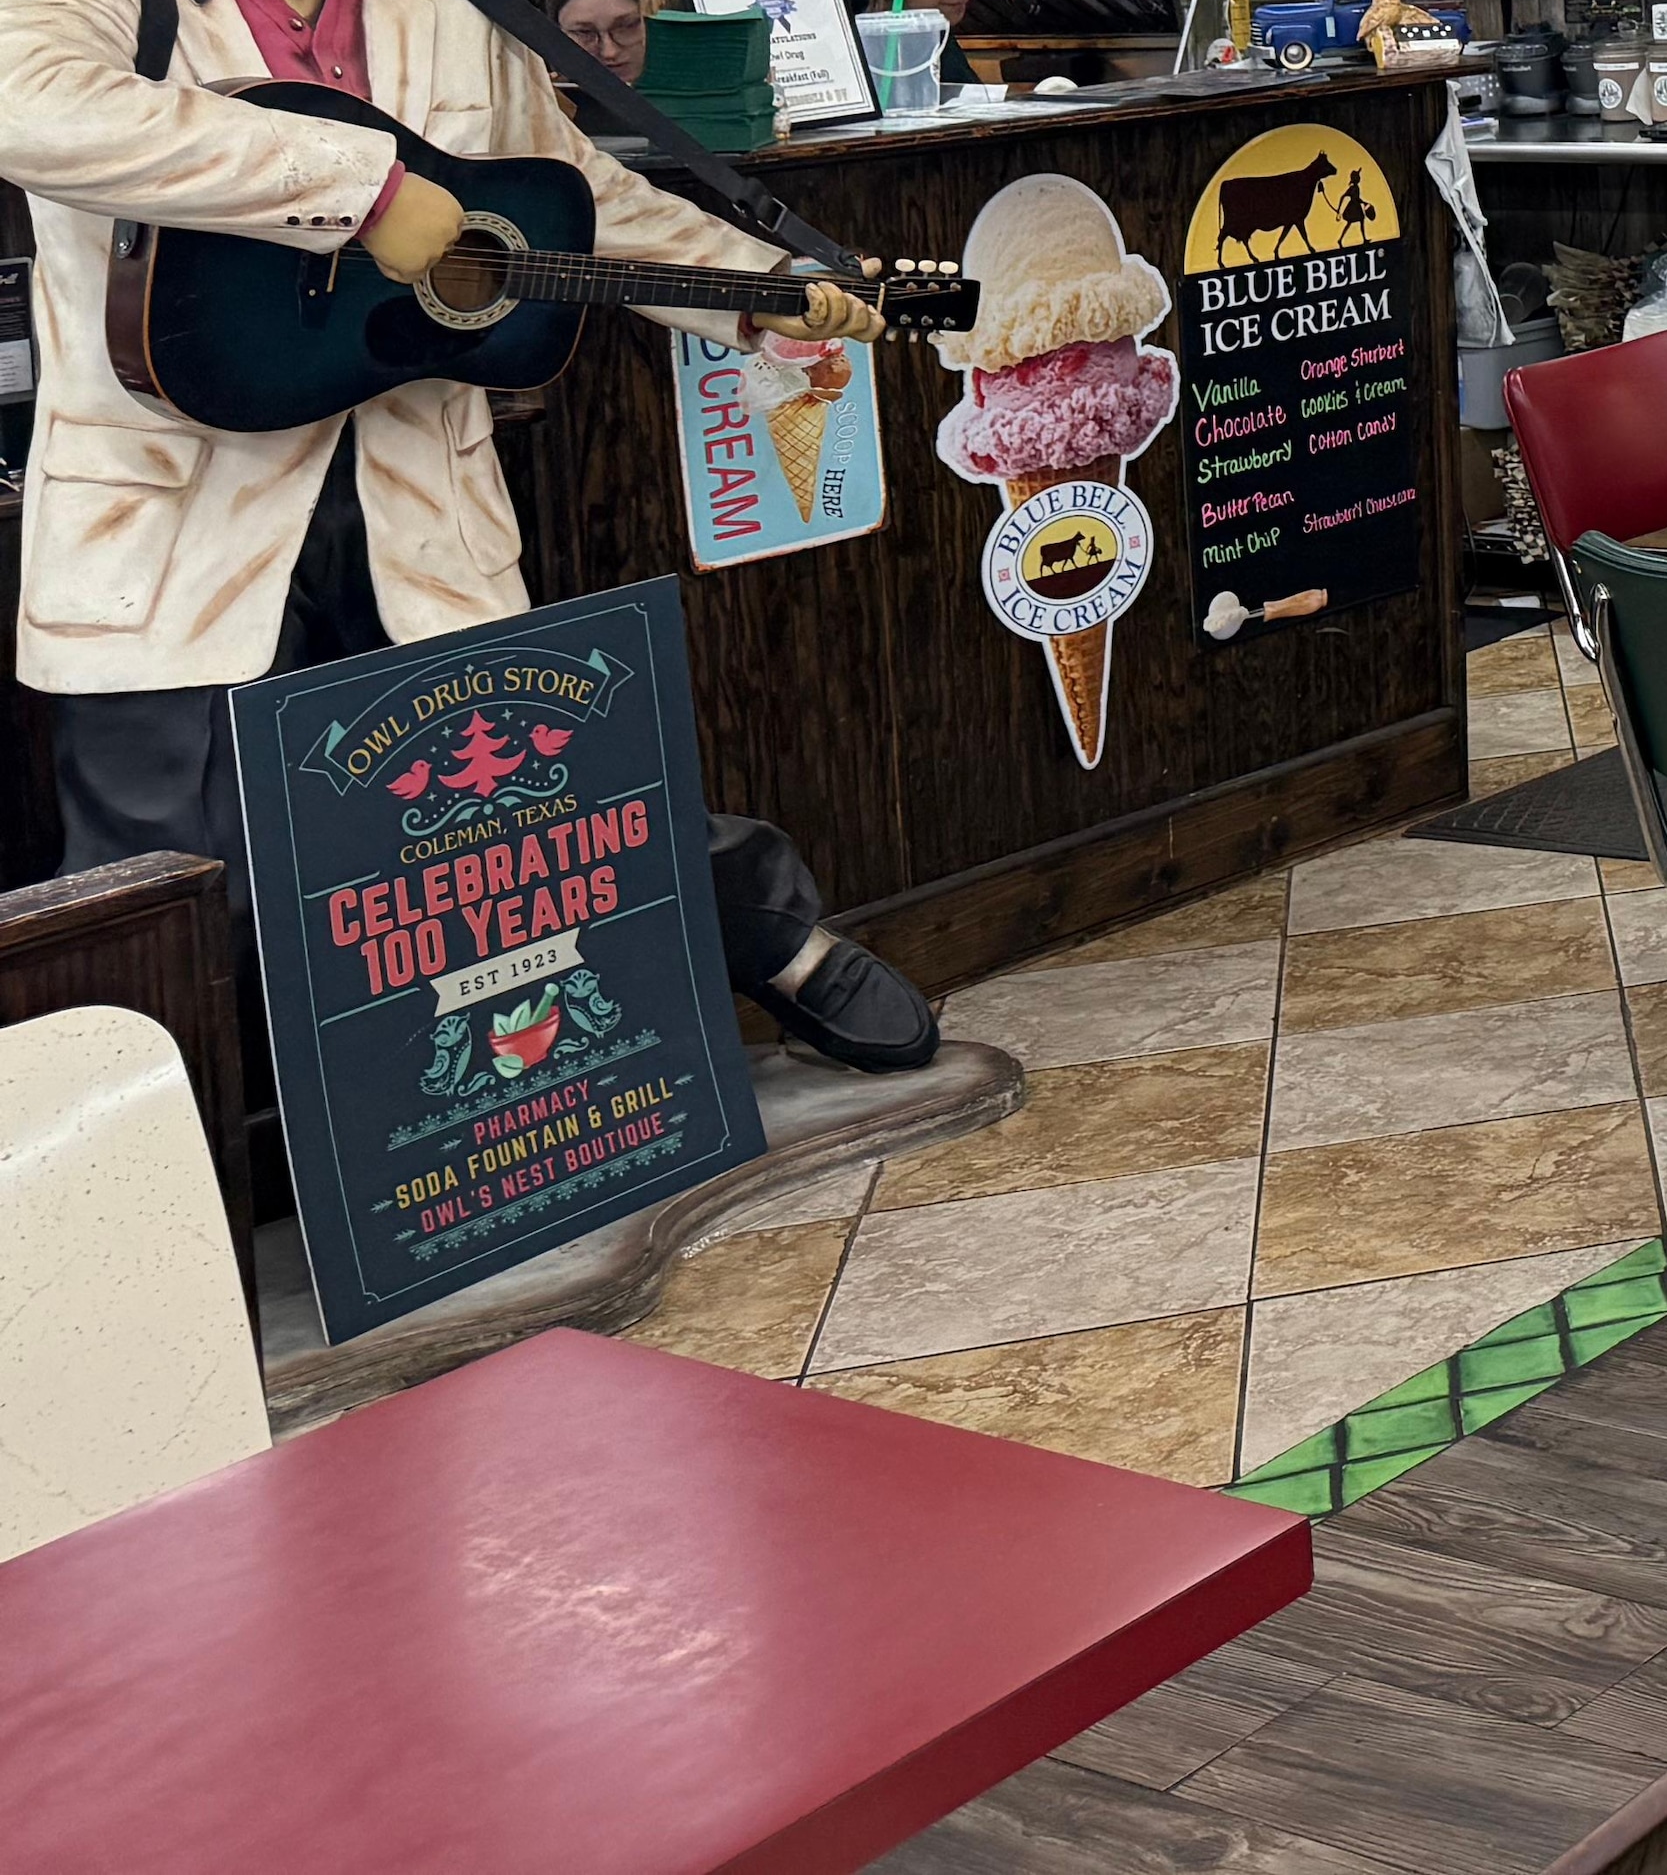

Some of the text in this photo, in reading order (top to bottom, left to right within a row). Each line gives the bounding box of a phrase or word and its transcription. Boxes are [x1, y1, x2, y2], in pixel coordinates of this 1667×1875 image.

[777, 73, 809, 84] reakfast
[1198, 248, 1387, 313] BLUE BELL
[1200, 288, 1393, 356] ICE CREAM
[1192, 376, 1262, 413] Vanilla
[1300, 354, 1348, 381] Orange
[697, 368, 763, 541] CREAM
[834, 401, 859, 465] SCOOP
[1195, 405, 1288, 447] Chocolate
[1308, 412, 1398, 455] Cotton Candy
[821, 468, 847, 520] HERE
[1197, 439, 1293, 484] Strawberry
[997, 485, 1131, 557] BLUE BELL
[1201, 490, 1295, 529] Butter Pecan
[1202, 537, 1244, 569] Mint
[1001, 558, 1144, 632] ICE CREAM
[347, 667, 595, 775] OWL DRUG STORE
[400, 793, 579, 865] COLEMAN, TEXAS
[328, 800, 649, 948] CELEBRATING
[360, 864, 619, 996] 100 YEARS
[458, 949, 558, 997] EST 1923
[395, 1077, 674, 1210] SODA FOUNTAIN & GRILL
[472, 1078, 590, 1145] PHARMACY
[420, 1112, 666, 1233] OWL'S NEST BOUTIQUE
